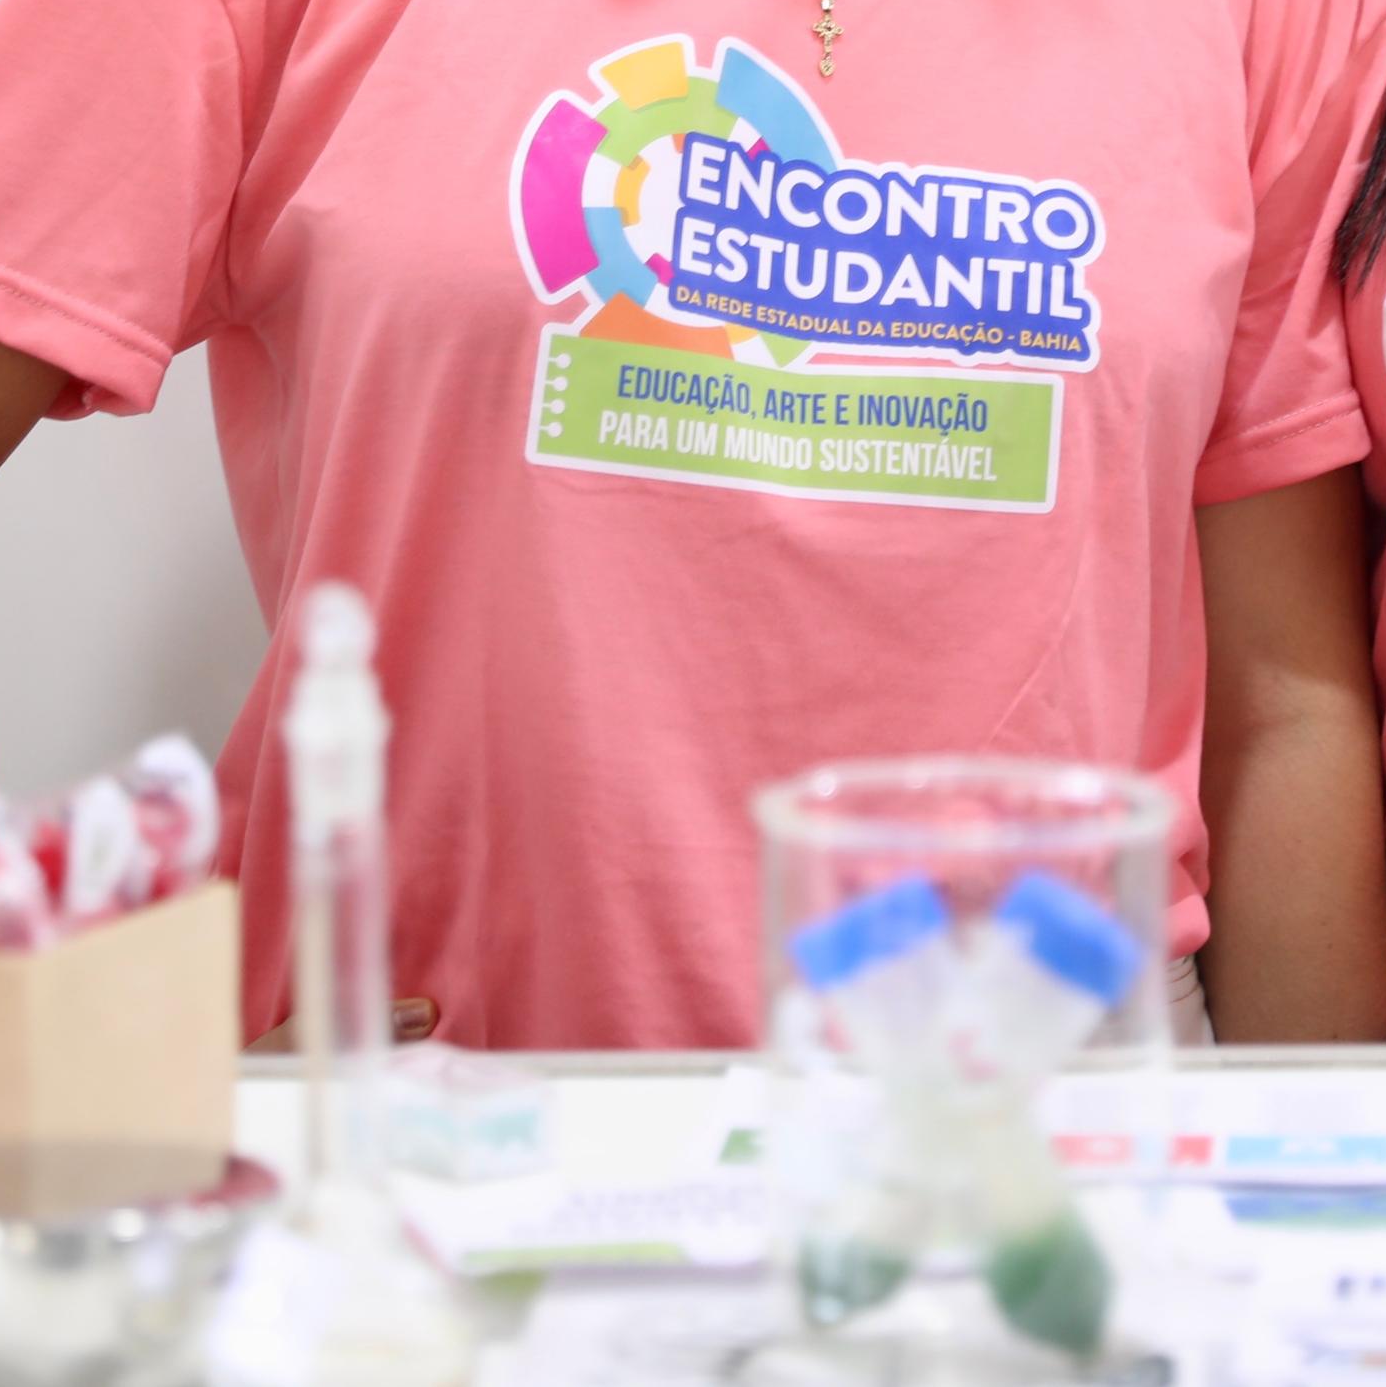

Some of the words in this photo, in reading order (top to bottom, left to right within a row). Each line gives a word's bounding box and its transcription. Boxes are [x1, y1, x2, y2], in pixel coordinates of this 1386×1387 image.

[686, 141, 1089, 250] ENCONTRO
[679, 216, 1083, 319] ESTUDANTIL
[676, 287, 701, 307] DA
[707, 294, 751, 318] REDE
[756, 305, 852, 336] ESTADUAL
[858, 320, 885, 337] DA
[891, 321, 1003, 346] EDUCAÇÃO
[1020, 331, 1082, 352] BAHIA
[617, 364, 756, 419] EDUCAÇÃO,
[763, 388, 826, 425] ARTE
[836, 394, 850, 425] E
[858, 392, 988, 436] INOVAÇÃO
[599, 410, 668, 450] PARA
[676, 419, 718, 456] UM
[724, 425, 812, 471] MUNDO
[819, 437, 997, 481] SUSTENTÁVEL
